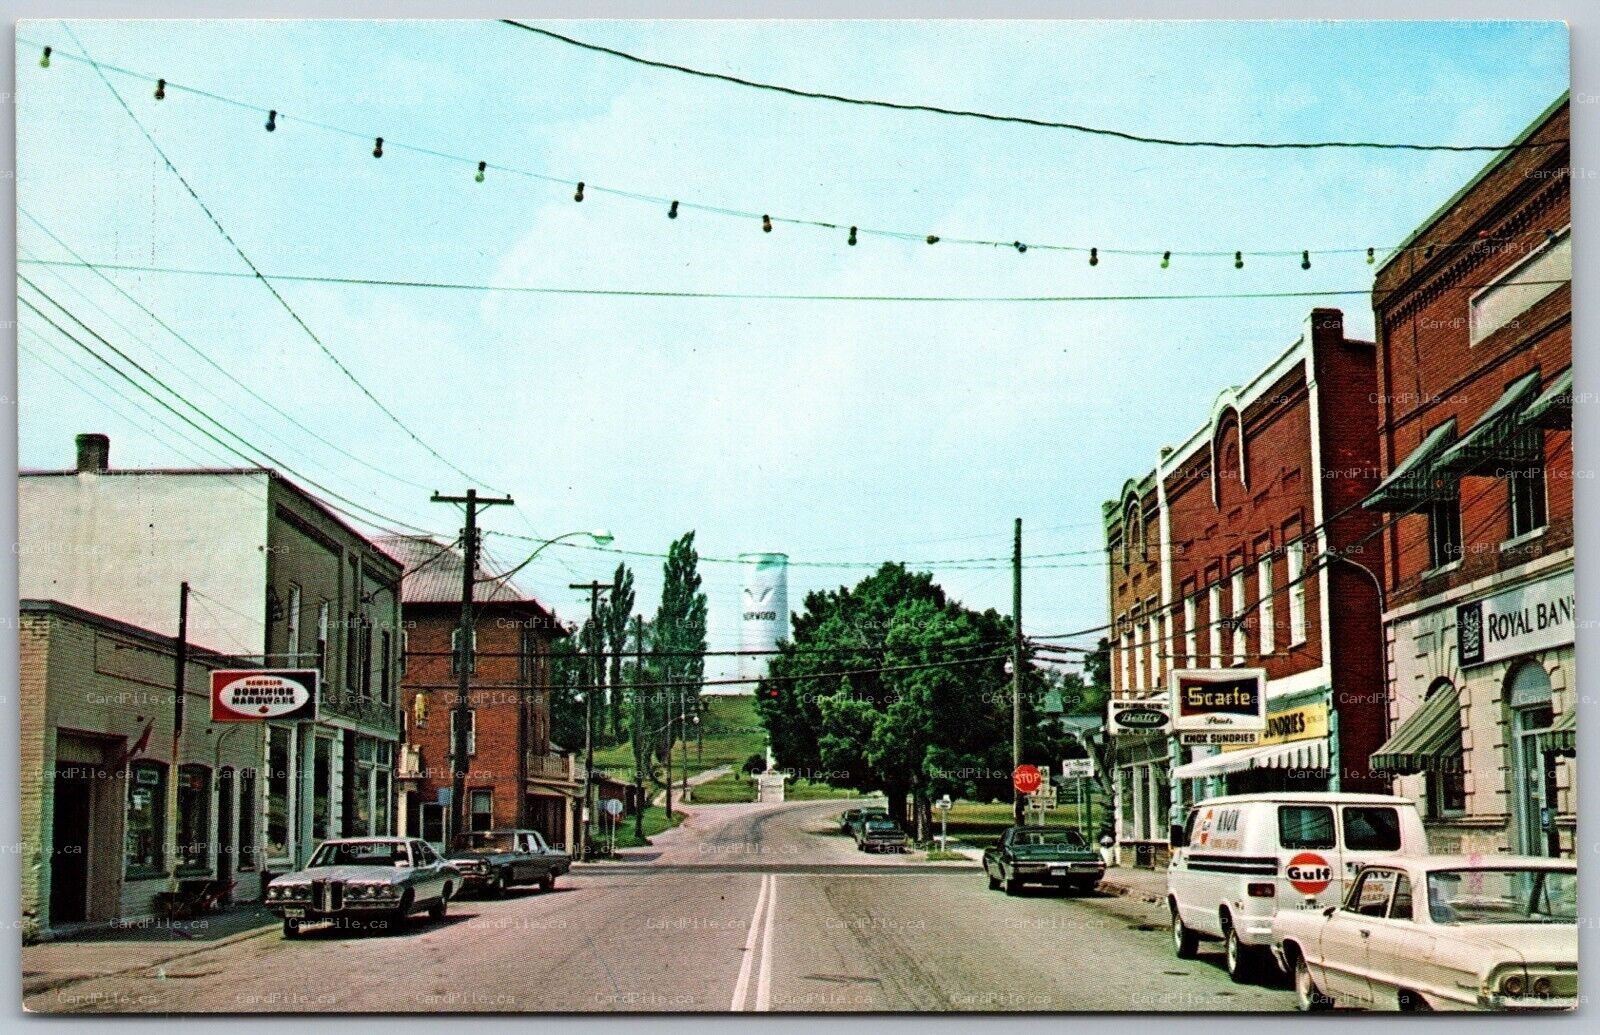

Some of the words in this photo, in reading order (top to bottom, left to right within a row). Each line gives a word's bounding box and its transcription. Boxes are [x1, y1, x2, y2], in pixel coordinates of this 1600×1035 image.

[1487, 608, 1534, 643] ROYAL
[233, 687, 295, 696] DOMINION
[1187, 686, 1251, 707] Scarfe
[231, 696, 296, 705] HARDWARE
[1183, 733, 1208, 744] KNOX
[1210, 732, 1256, 744] SUNDRIES
[1015, 772, 1041, 785] STOP
[1287, 866, 1331, 881] Gulf
